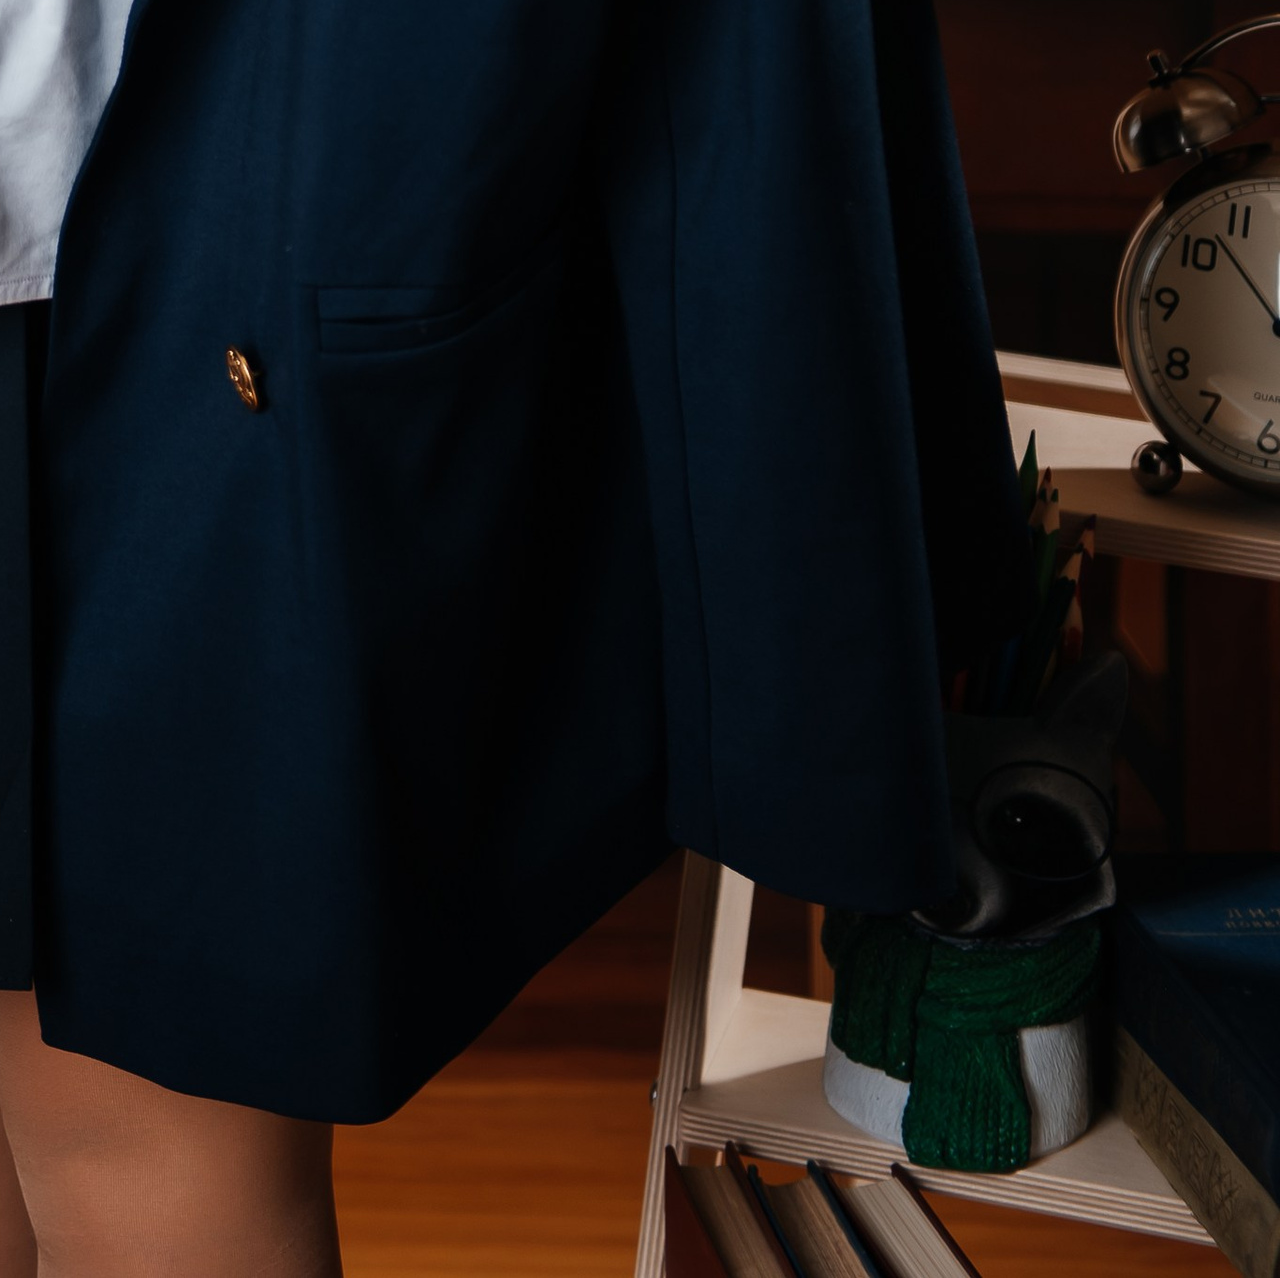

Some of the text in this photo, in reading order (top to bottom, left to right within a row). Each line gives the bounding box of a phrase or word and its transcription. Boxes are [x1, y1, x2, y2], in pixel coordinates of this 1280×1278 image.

[1227, 202, 1252, 239] 11
[1180, 233, 1218, 272] 10
[1154, 286, 1180, 322] 9
[1165, 346, 1191, 382] 8
[1198, 389, 1222, 425] 7
[1256, 418, 1280, 456] 6
